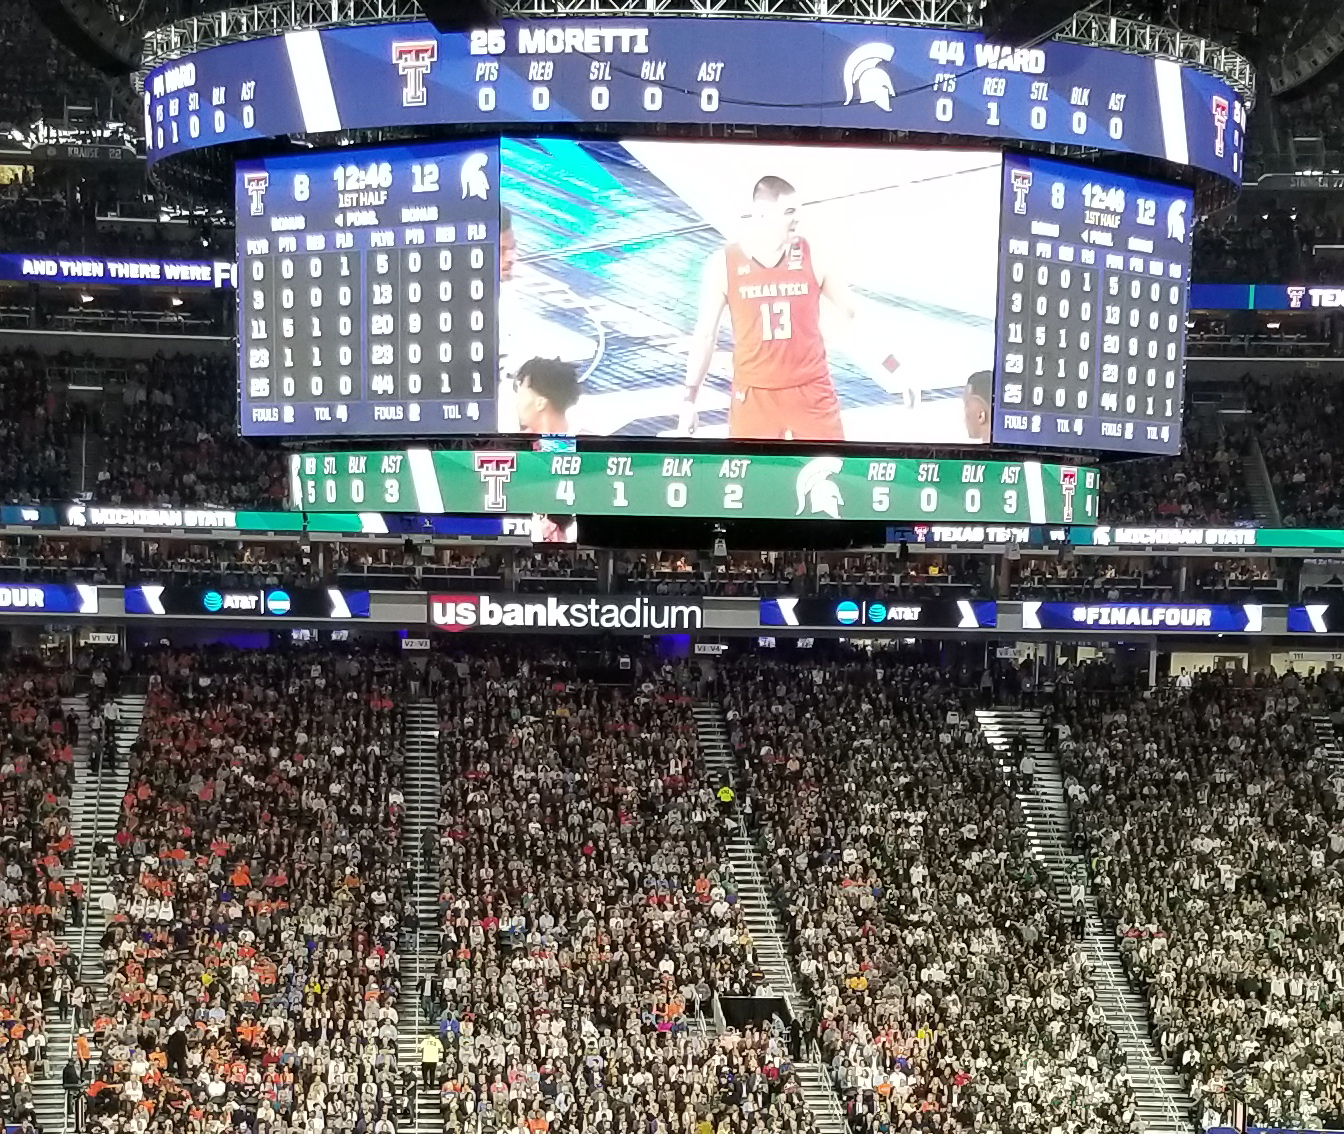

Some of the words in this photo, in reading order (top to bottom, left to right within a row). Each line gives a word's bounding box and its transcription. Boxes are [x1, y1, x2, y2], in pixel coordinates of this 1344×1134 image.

[471, 29, 505, 54] 25
[519, 27, 648, 53] MORETTI
[929, 40, 964, 66] 44
[975, 44, 1045, 73] WARD
[476, 62, 498, 81] PTS
[529, 61, 553, 80] REB
[590, 61, 611, 80] STL
[641, 61, 666, 80] BLK
[697, 62, 724, 81] AST
[479, 87, 495, 111] 0
[532, 86, 549, 110] 0
[591, 86, 609, 110] 0
[644, 86, 662, 110] 0
[701, 87, 718, 111] 0
[983, 77, 1005, 96] REB
[1030, 81, 1048, 100] STL
[1071, 87, 1090, 105] BLK
[1109, 93, 1126, 111] AST
[936, 97, 952, 121] 0
[987, 102, 999, 125] 1
[1031, 106, 1046, 129] 0
[1073, 111, 1086, 134] 0
[1110, 117, 1122, 139] 0
[294, 174, 309, 201] 8
[334, 163, 392, 193] 12:46
[412, 164, 439, 192] 12
[1052, 182, 1065, 209] 8
[1137, 199, 1155, 225] 12
[23, 260, 57, 275] AND
[60, 261, 103, 276] THEN
[107, 263, 160, 278] THERE
[164, 264, 211, 280] WERE
[760, 303, 792, 339] 13
[375, 406, 403, 420] FOULS
[324, 457, 336, 474] STL
[349, 457, 366, 473] BLK
[381, 456, 403, 473] AST
[552, 457, 581, 474] REB
[607, 458, 633, 475] STL
[662, 458, 693, 476] BLK
[719, 460, 750, 478] AST
[868, 463, 895, 480] REB
[918, 464, 939, 481] STL
[962, 465, 985, 482] BLK
[1001, 467, 1020, 483] AST
[352, 480, 363, 502] 0
[385, 479, 399, 502] 3
[556, 481, 575, 505] 4
[614, 481, 628, 506] 1
[667, 482, 686, 507] 0
[724, 484, 743, 508] 2
[873, 486, 889, 511] 5
[921, 488, 937, 511] 0
[966, 489, 980, 512] 0
[1004, 490, 1016, 513] 3
[224, 595, 258, 609] AT&T
[888, 607, 921, 620] AT&T
[1073, 607, 1211, 626] #FINALFOUR
